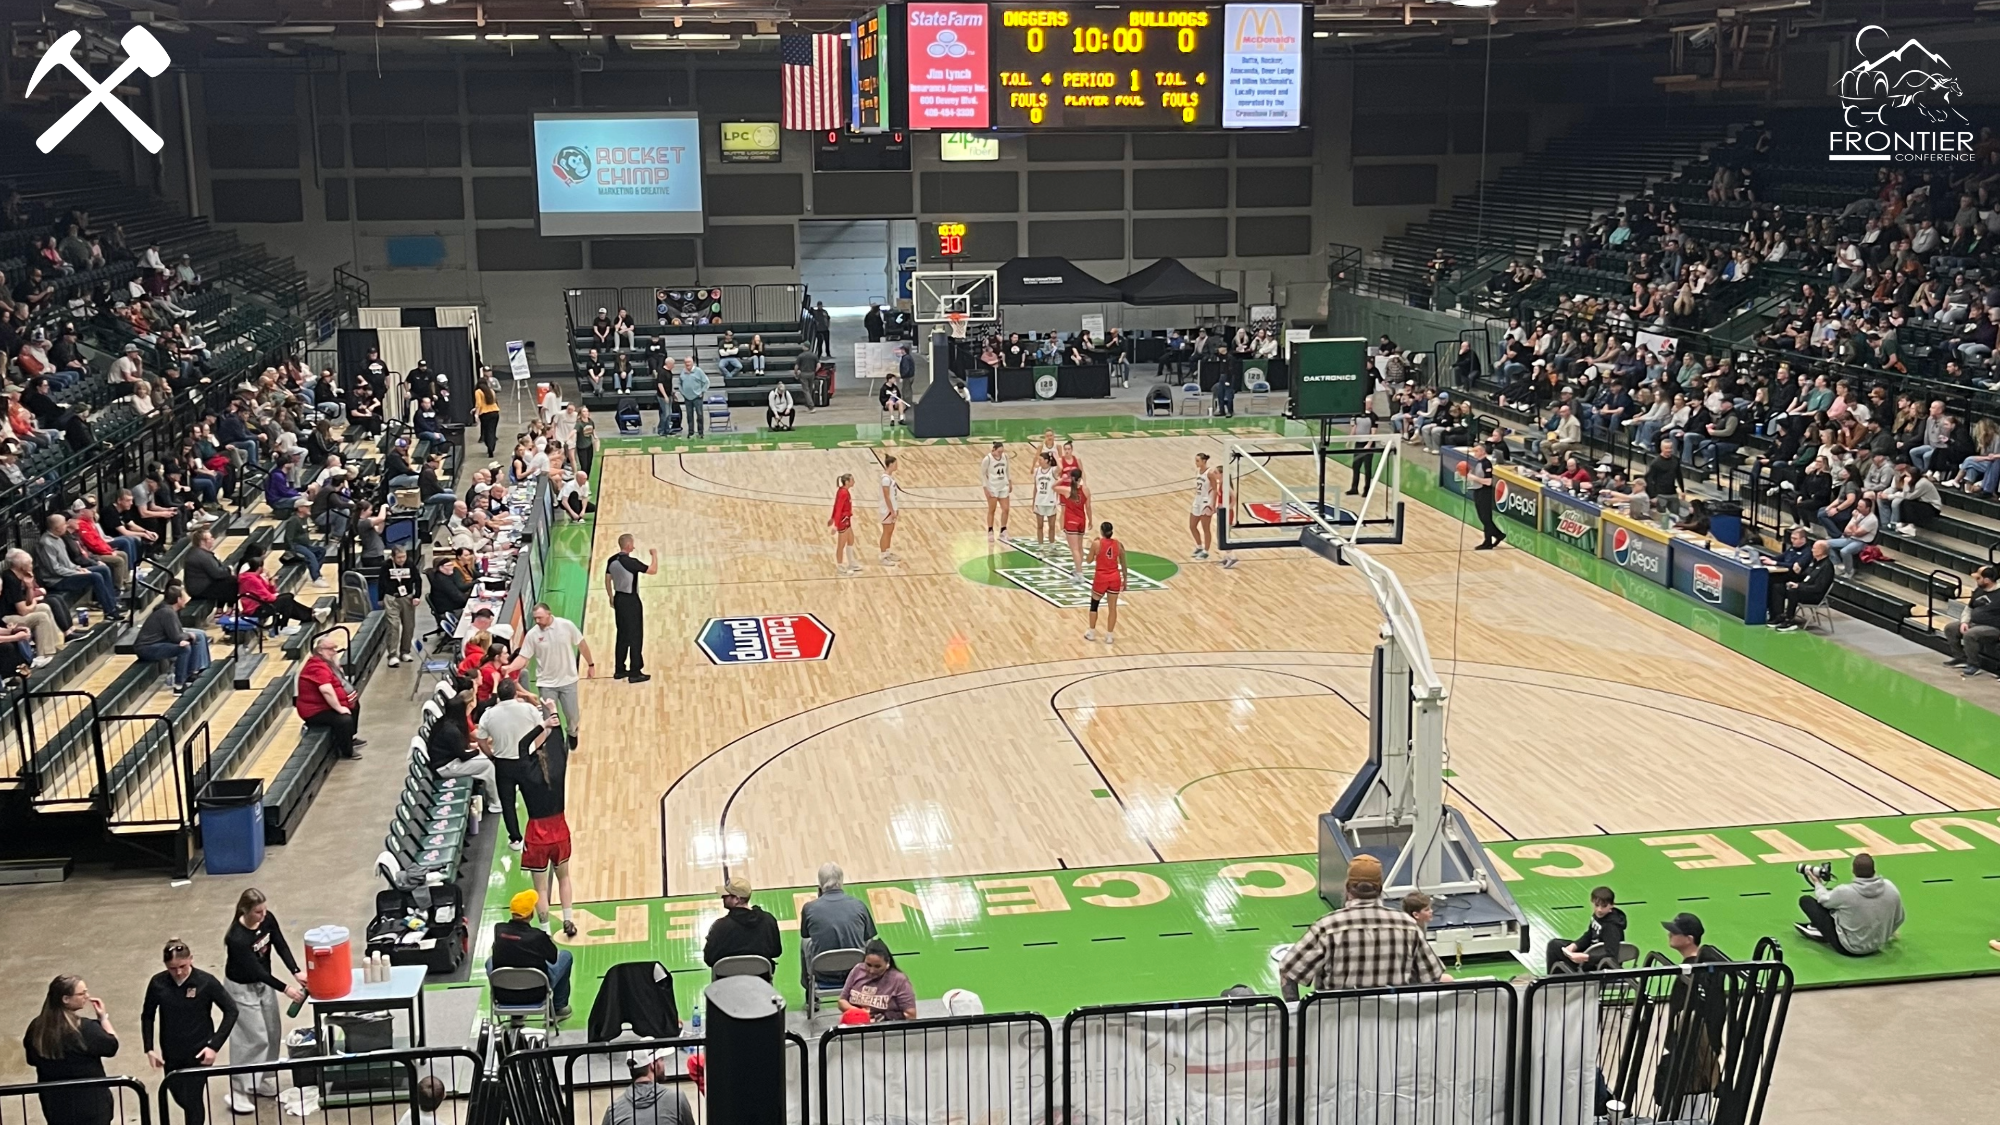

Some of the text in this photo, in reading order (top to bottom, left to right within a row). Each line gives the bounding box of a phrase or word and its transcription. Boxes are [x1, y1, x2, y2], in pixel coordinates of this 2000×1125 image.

[1003, 11, 1069, 27] DIGGERS
[1129, 11, 1209, 27] BULLDOGS
[1027, 27, 1044, 53] 0
[1072, 27, 1144, 53] 10:00
[1178, 27, 1195, 53] 0
[1242, 36, 1296, 44] McDonald's
[926, 68, 972, 81] Jim Lynch
[1000, 72, 1052, 86] T.O.L. 4
[1062, 69, 1140, 92] PERIOD 1
[1154, 72, 1206, 86] T.O.L. 4
[909, 83, 988, 94] Insurance Agency Inc.
[1234, 88, 1289, 97] Locally owned and
[960, 95, 979, 105] Blvd.
[1010, 92, 1048, 108] FOULS
[1064, 95, 1145, 106] PLAYER FOUL
[1162, 92, 1199, 107] FOULS
[1237, 99, 1265, 107] operated
[1265, 99, 1274, 107] by
[1030, 107, 1043, 124] 0
[1183, 107, 1195, 123] 0
[723, 131, 750, 141] LPC
[828, 131, 837, 143] 0
[595, 146, 686, 165] ROCKET
[969, 147, 992, 156] fiber
[596, 167, 670, 185] CHIMP
[598, 186, 670, 195] MARKETING & CREATIVE
[941, 236, 962, 255] 30
[836, 435, 1007, 448] CIVIC
[996, 468, 1005, 476] 44
[1040, 481, 1048, 491] 31
[1508, 492, 1536, 517] pepsi
[1105, 546, 1113, 559] 4
[1629, 550, 1659, 573] pepsi
[1696, 568, 1720, 588] town
[1695, 580, 1720, 598] pump
[723, 619, 764, 660] pump
[766, 617, 801, 659] town
[1639, 817, 2000, 871] UTTE
